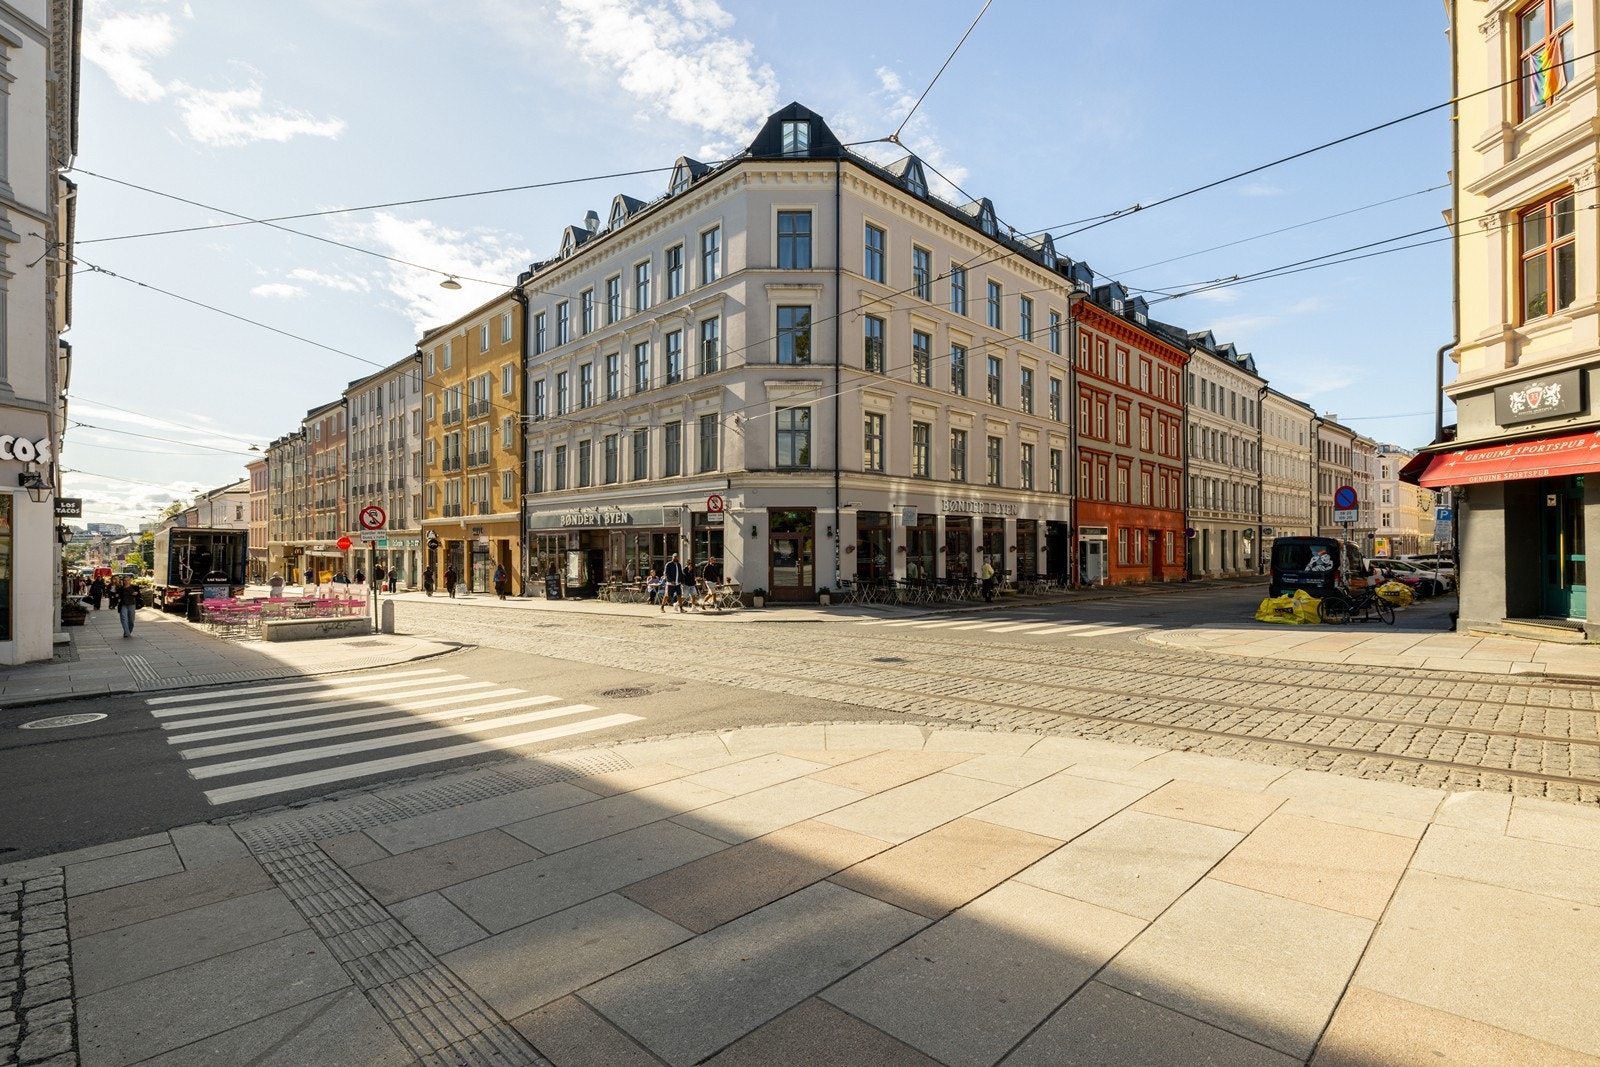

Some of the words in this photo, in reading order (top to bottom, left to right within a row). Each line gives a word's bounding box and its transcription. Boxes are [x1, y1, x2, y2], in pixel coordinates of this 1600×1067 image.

[1465, 449, 1513, 461] GENUINE
[1514, 439, 1586, 455] SPORTSPUB
[1468, 471, 1501, 483] GENUINE
[1503, 469, 1550, 480] SPORTSPUB
[943, 500, 985, 513] BØNDER
[996, 503, 1018, 515] BYEN
[1440, 510, 1449, 519] P
[560, 514, 595, 526] BØNDER
